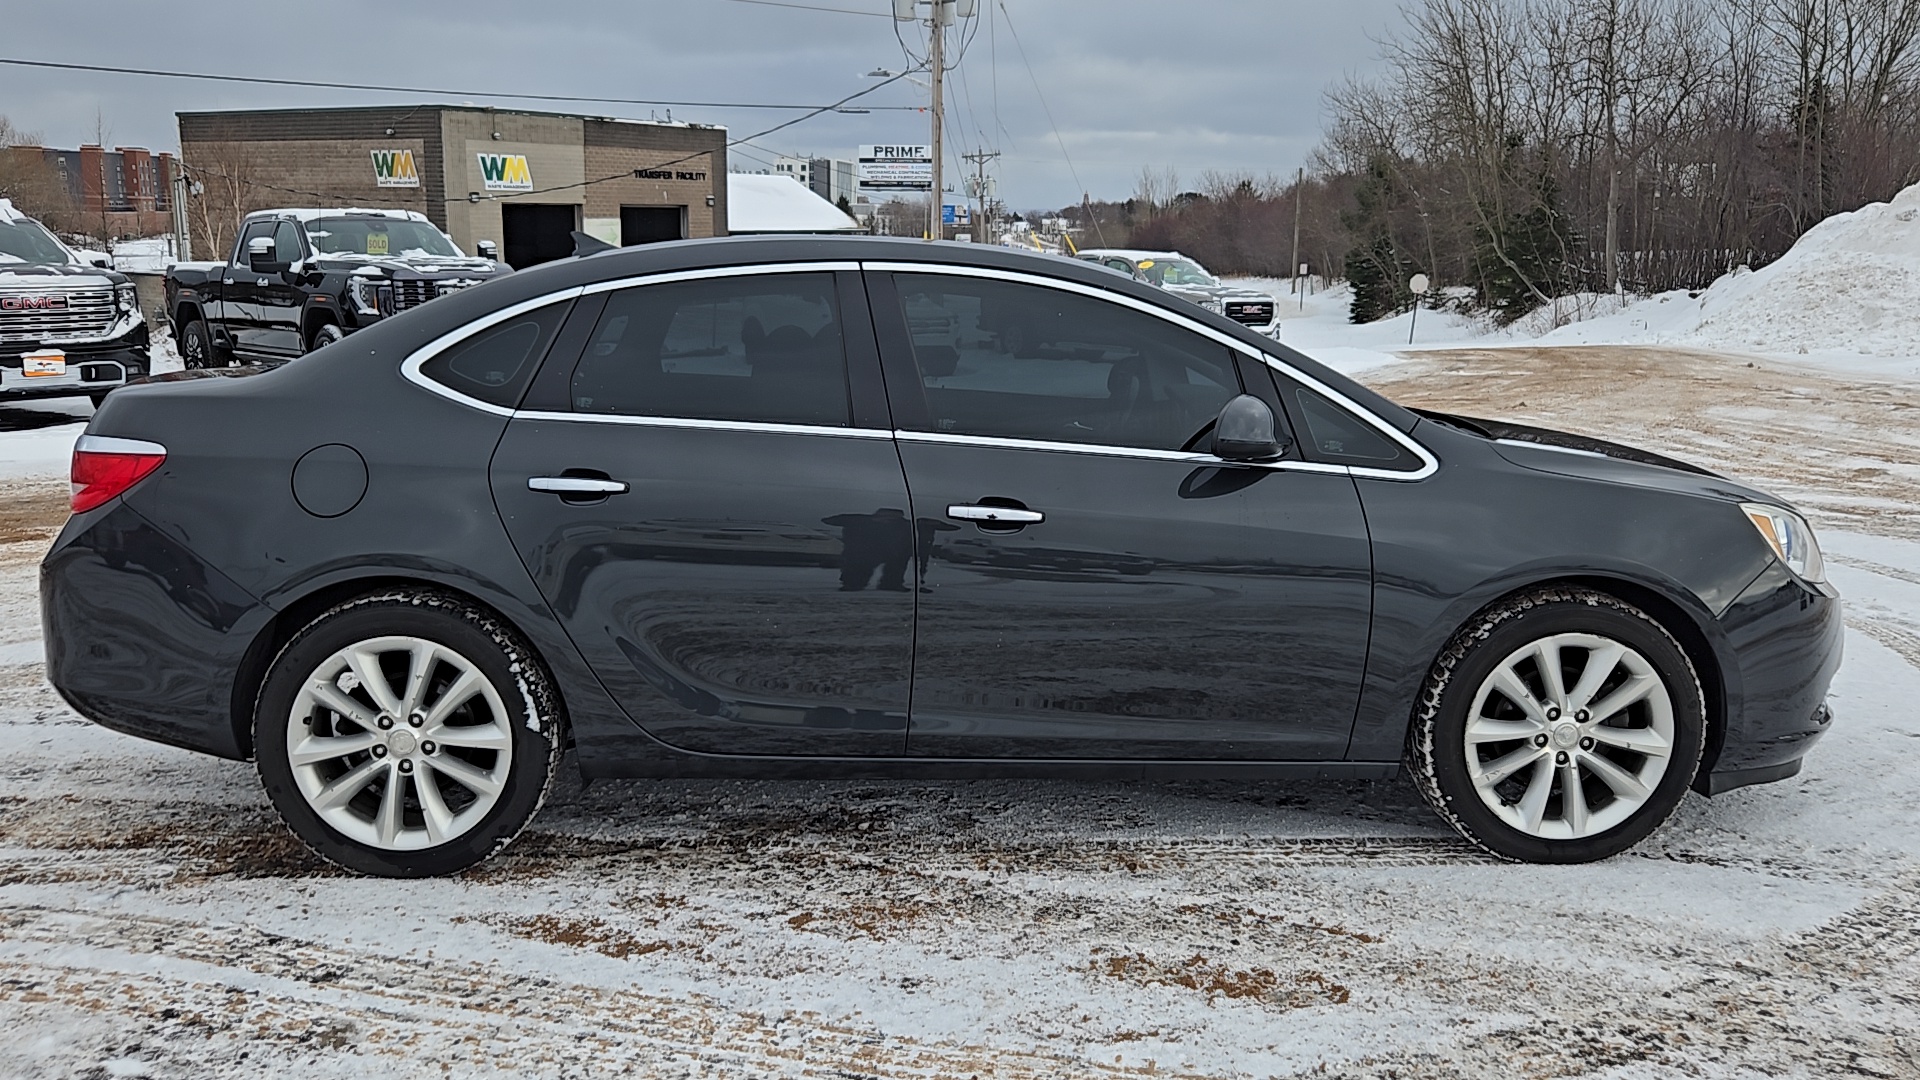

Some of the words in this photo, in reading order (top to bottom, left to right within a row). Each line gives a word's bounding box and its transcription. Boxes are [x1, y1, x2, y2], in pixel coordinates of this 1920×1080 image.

[873, 146, 925, 158] PRIME
[372, 152, 417, 178] WM
[480, 156, 530, 182] WM
[634, 169, 673, 180] TRANSFER
[676, 171, 707, 181] FACILITY
[368, 239, 387, 249] SOLD
[2, 296, 66, 310] GMC
